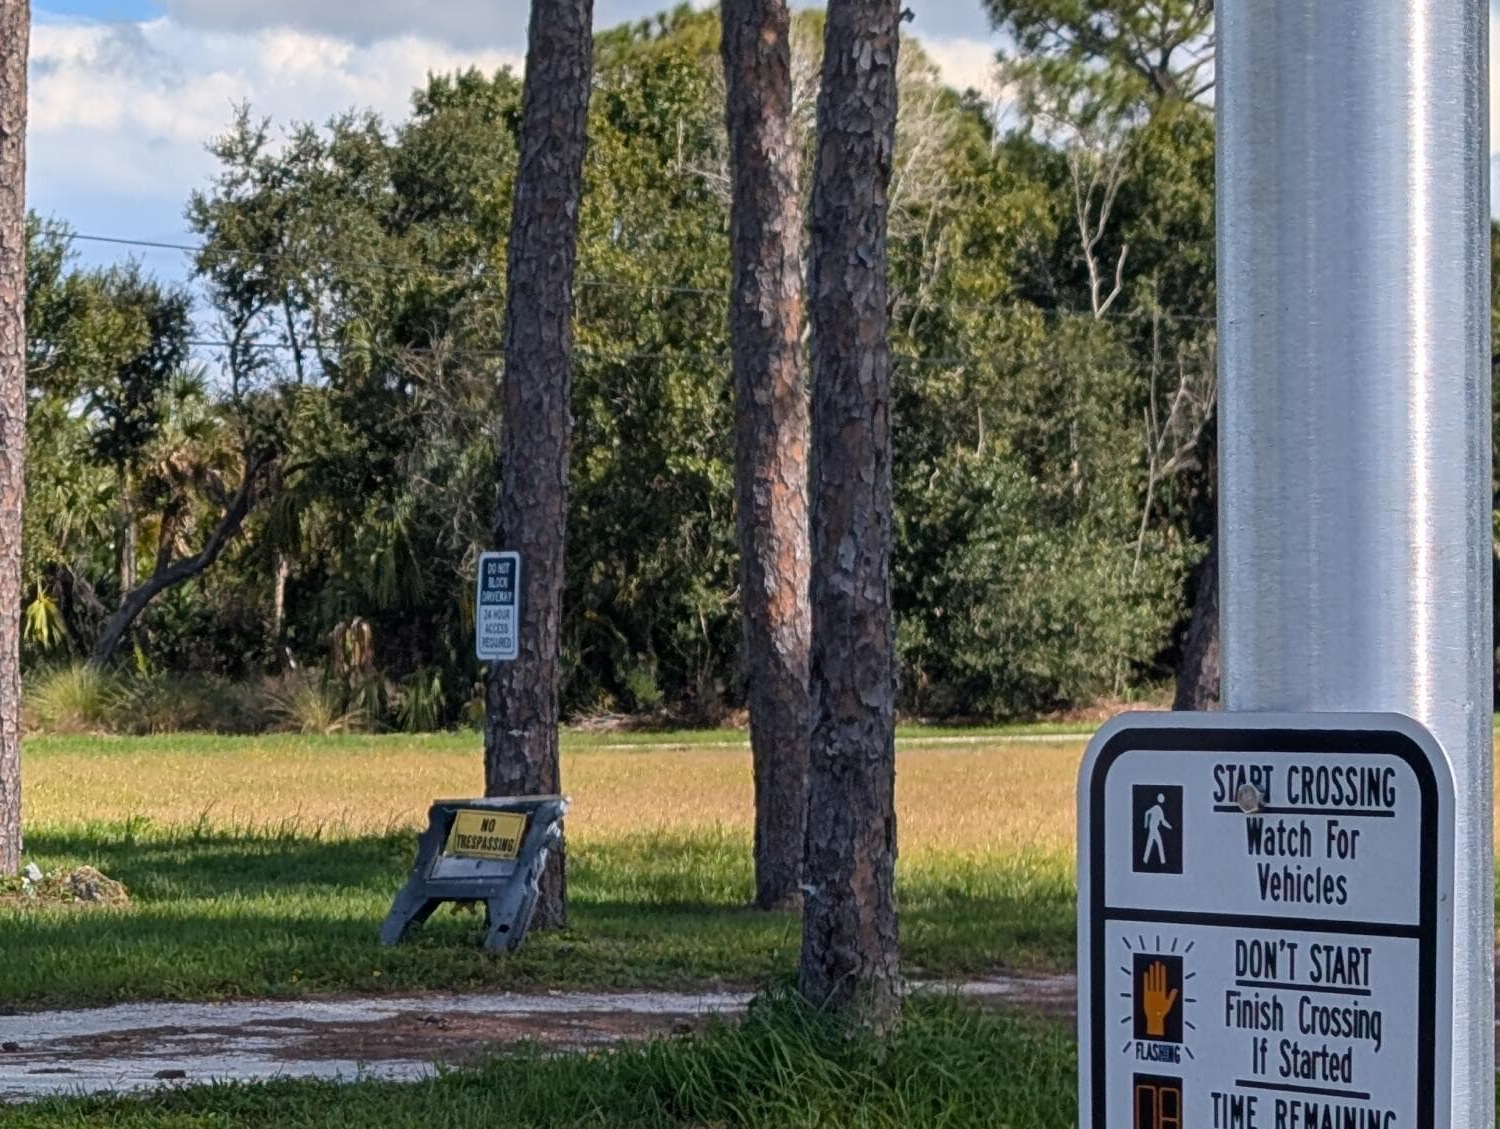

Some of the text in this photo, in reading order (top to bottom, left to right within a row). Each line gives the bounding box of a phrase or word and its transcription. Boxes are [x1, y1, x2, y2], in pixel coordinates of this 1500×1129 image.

[487, 562, 496, 575] DO
[488, 577, 508, 588] BLOCK
[485, 623, 508, 633] ACCESS
[1287, 766, 1395, 808] CROSSING
[480, 818, 496, 832] NO
[1246, 817, 1360, 859] Watch For
[456, 834, 514, 852] TRESPASSING
[1258, 863, 1347, 904] Vehicles
[1236, 939, 1371, 986] DON'T START
[1225, 991, 1382, 1052] Finish Crossing
[1135, 1042, 1180, 1064] FLASHING
[1253, 1037, 1352, 1083] If Started
